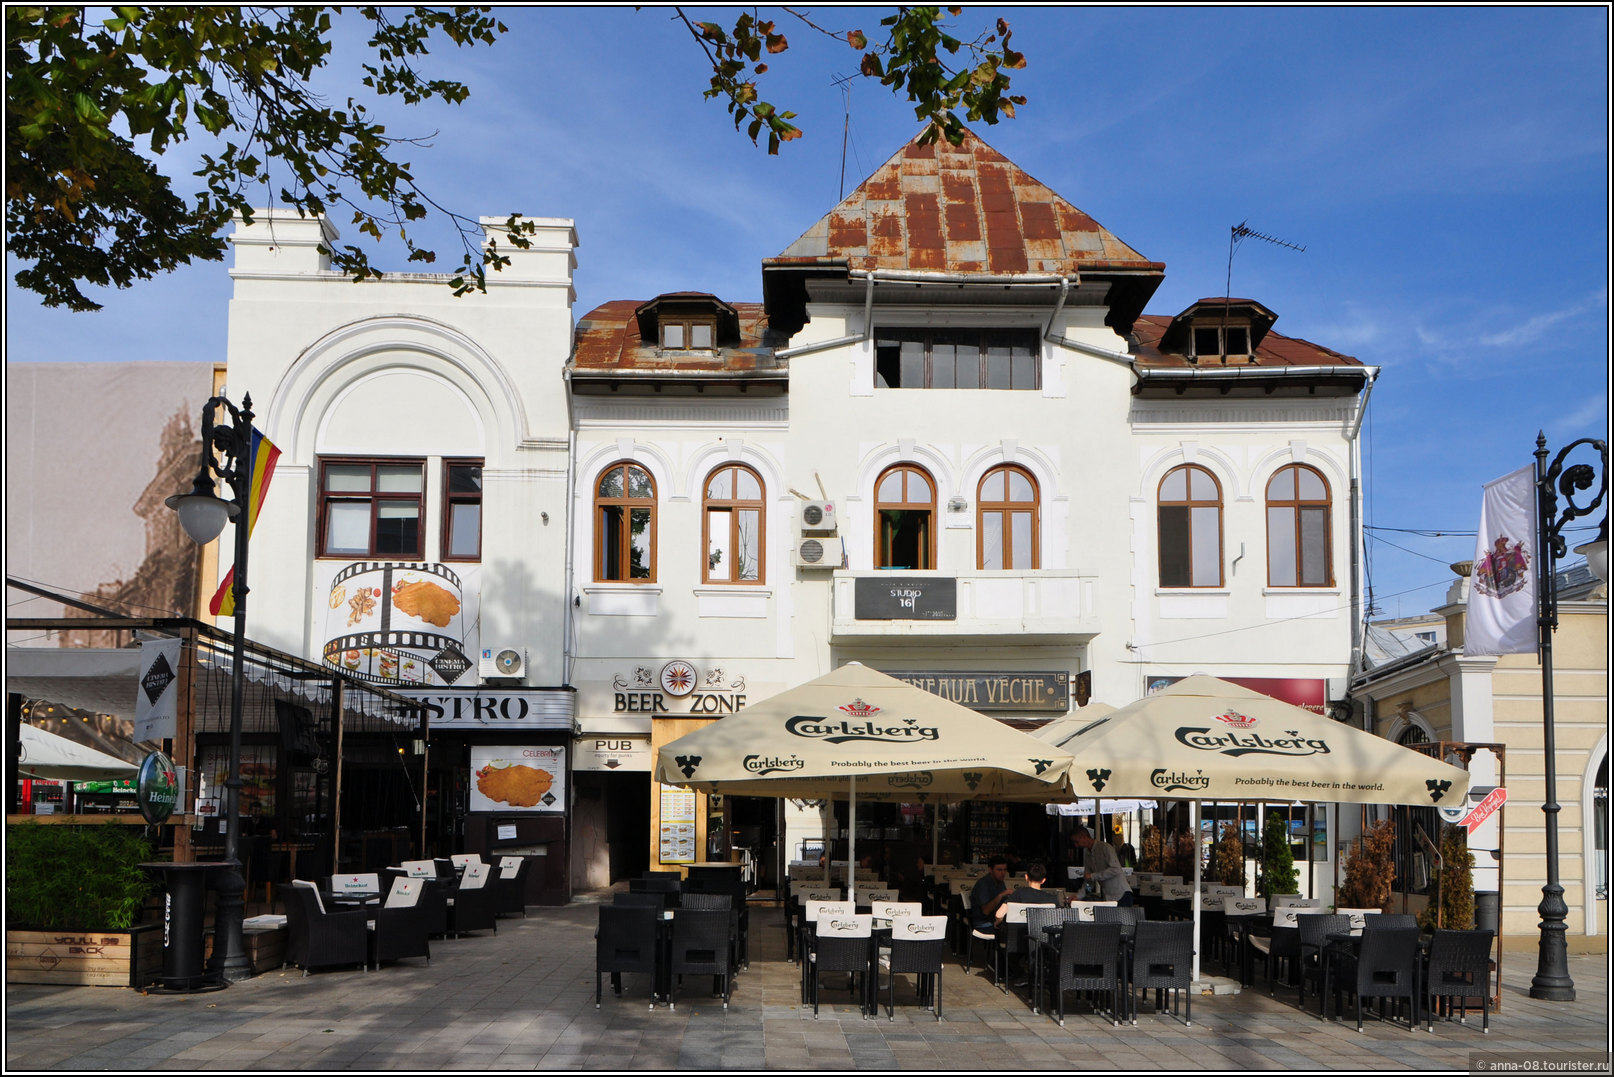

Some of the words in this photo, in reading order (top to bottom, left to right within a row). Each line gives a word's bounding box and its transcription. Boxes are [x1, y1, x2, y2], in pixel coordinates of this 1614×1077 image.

[890, 589, 922, 597] STUDIO
[900, 598, 912, 608] 16
[985, 678, 1046, 703] VECHE
[614, 692, 669, 712] BEER
[785, 715, 940, 745] Carlsberg
[595, 740, 633, 751] PUB
[1174, 726, 1332, 757] Carlsberg
[743, 754, 805, 776] Carlsberg
[1150, 768, 1210, 793] Carlsberg
[1235, 778, 1275, 787] Probably
[1311, 780, 1331, 788] beer
[1332, 781, 1340, 789] in
[1342, 782, 1356, 790] the
[1358, 783, 1385, 791] world.
[830, 920, 859, 931] Carlsberg
[907, 923, 935, 934] Carlsberg
